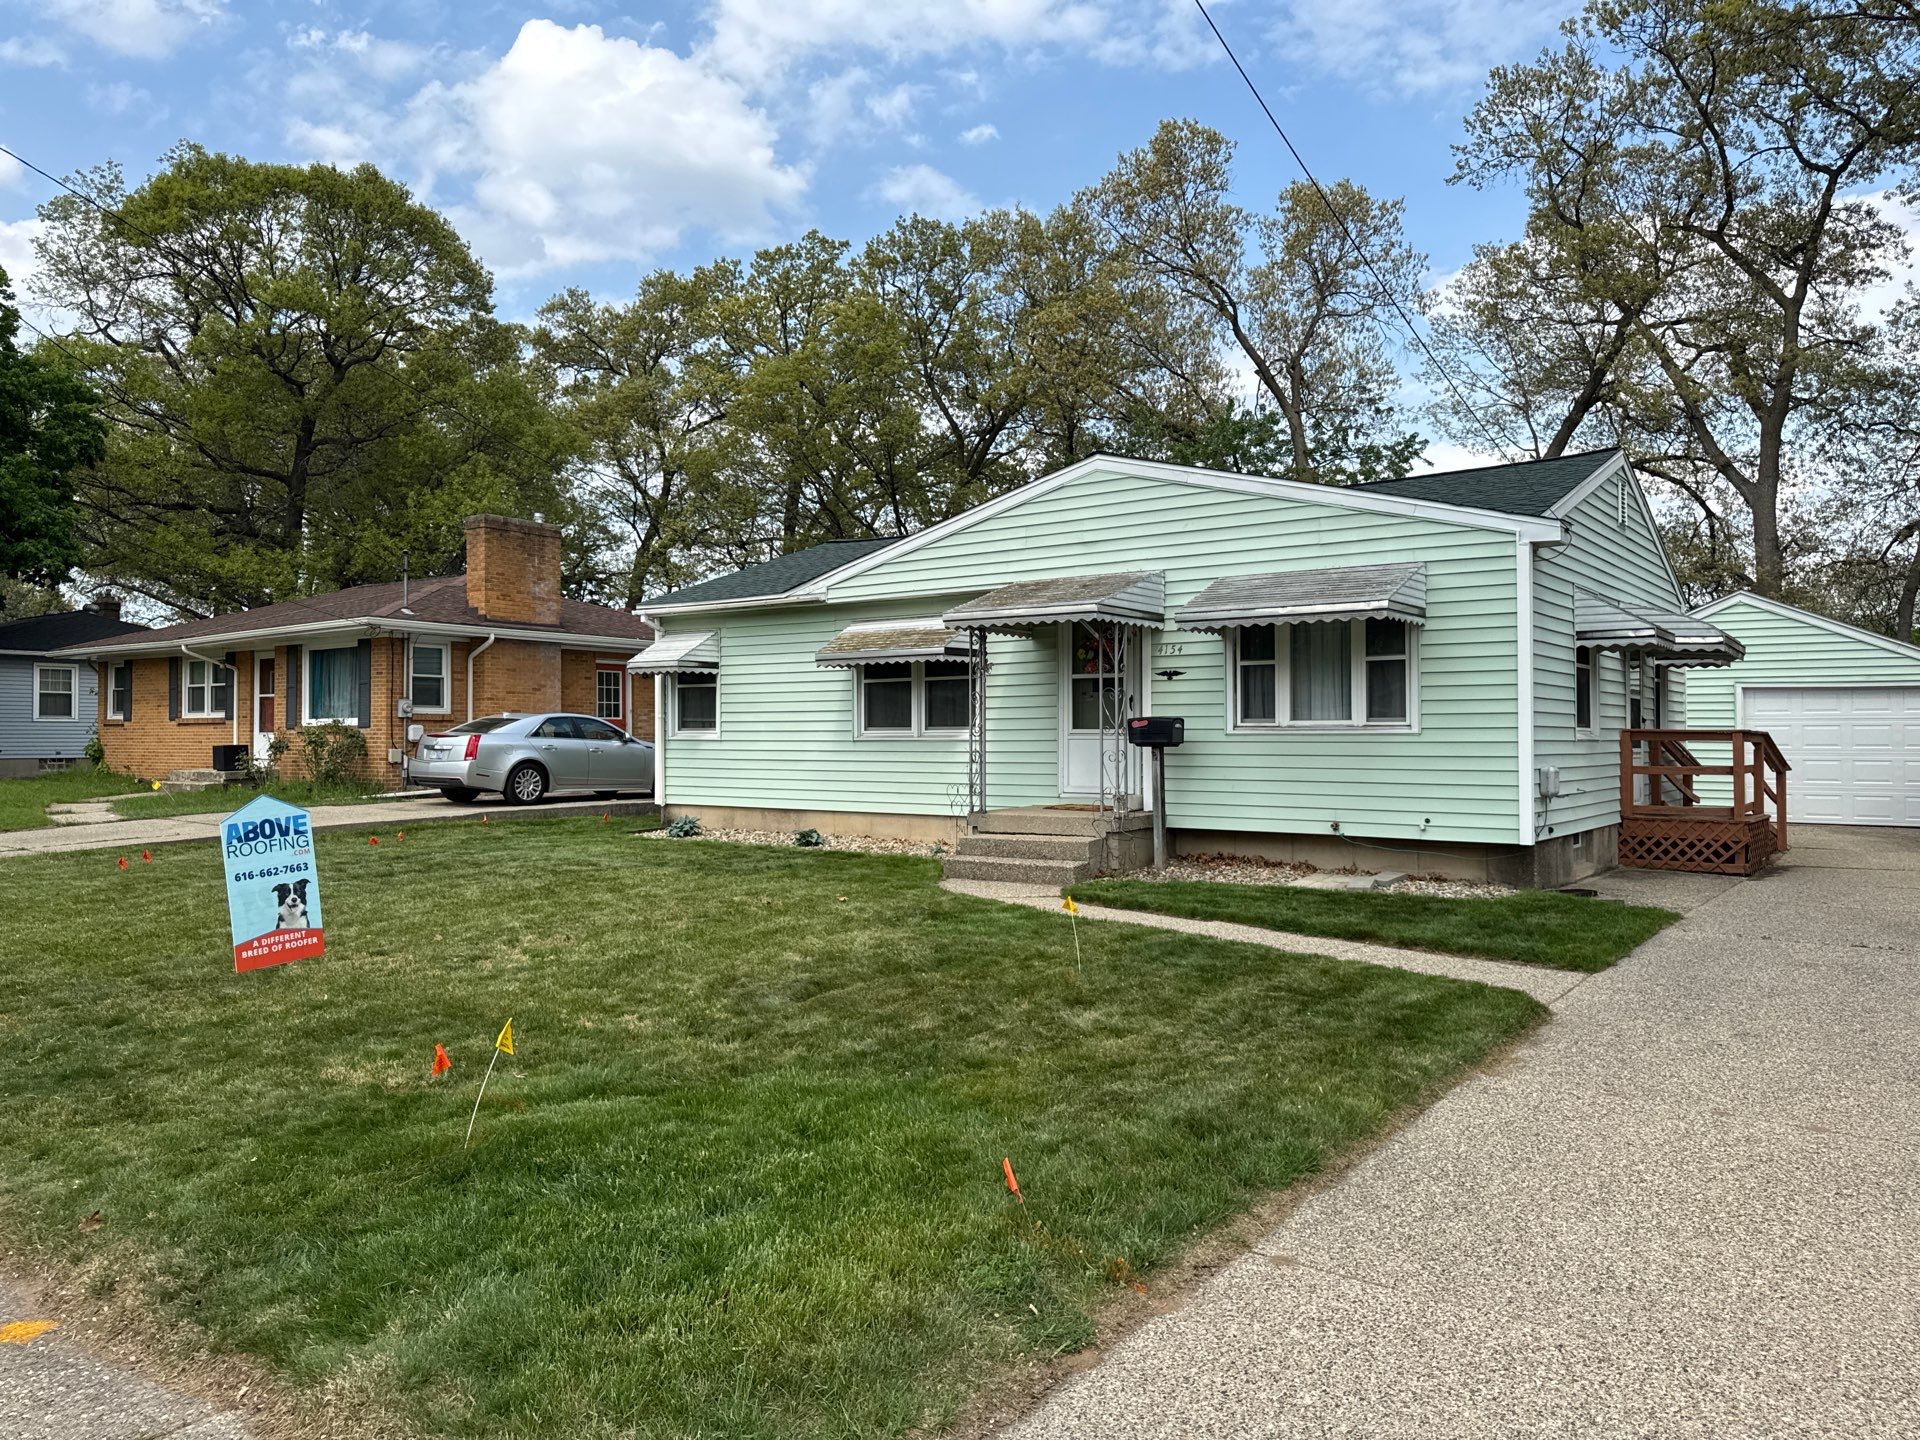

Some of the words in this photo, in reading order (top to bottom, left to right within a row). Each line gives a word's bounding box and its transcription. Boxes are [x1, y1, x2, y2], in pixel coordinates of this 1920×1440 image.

[1157, 645, 1183, 655] 4154
[226, 814, 308, 845] ABOVE
[226, 835, 310, 859] ROOFING
[234, 862, 309, 882] 616-662-7663
[241, 946, 269, 959] BREED
[272, 943, 283, 953] OF
[285, 937, 318, 950] ROOFER
[252, 939, 259, 947] A
[261, 931, 306, 946] DIFFERENT
